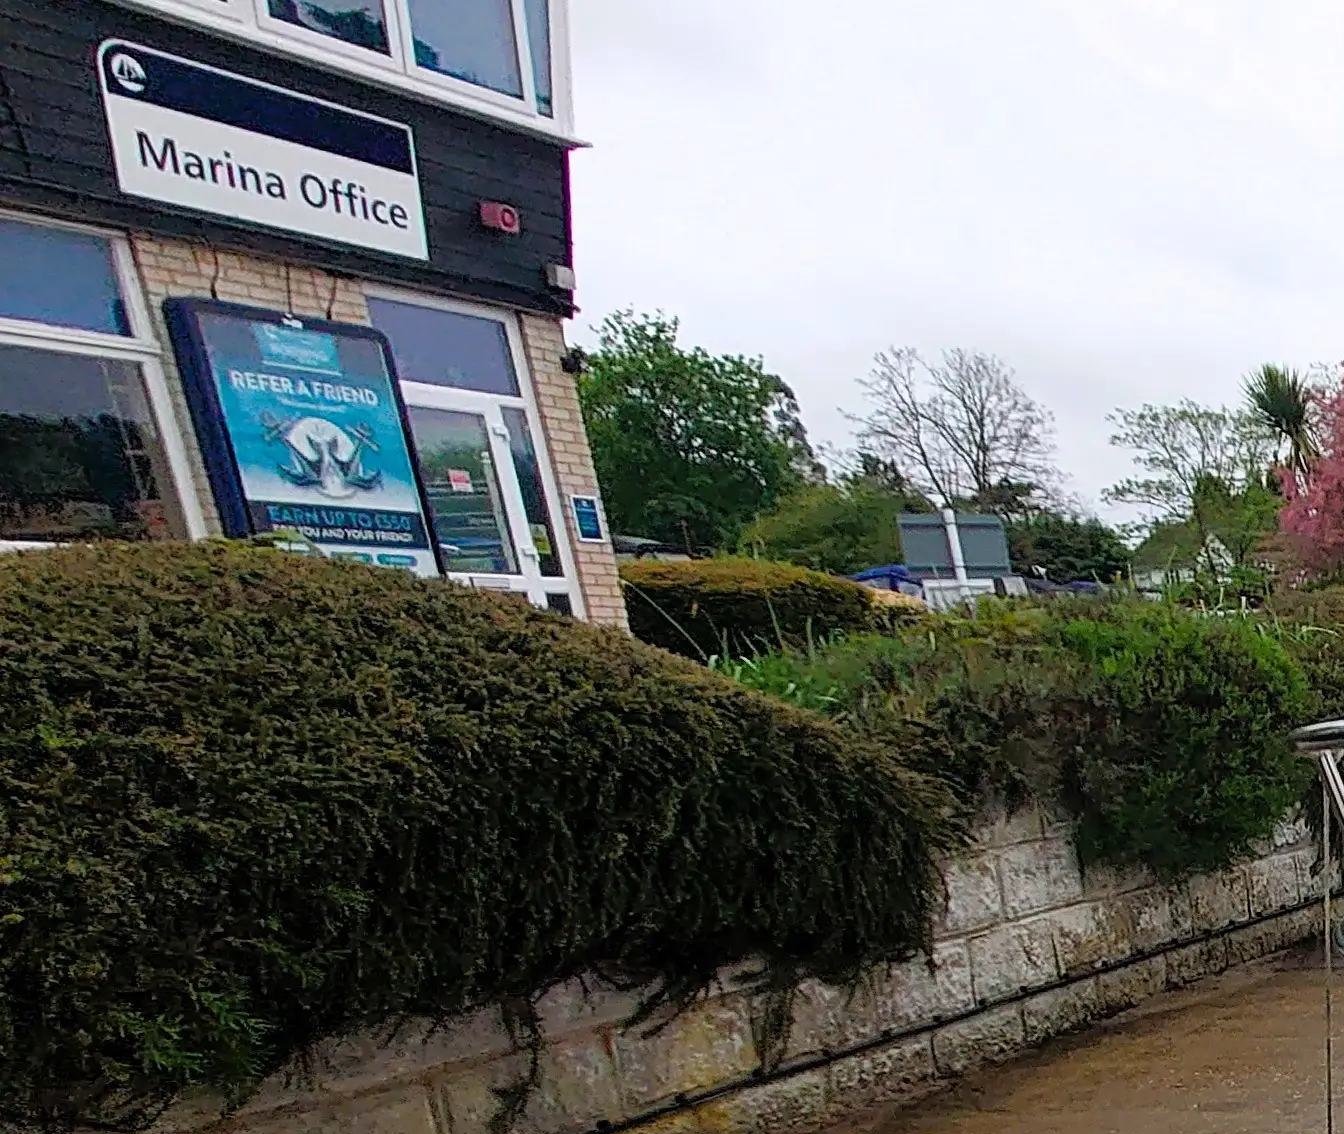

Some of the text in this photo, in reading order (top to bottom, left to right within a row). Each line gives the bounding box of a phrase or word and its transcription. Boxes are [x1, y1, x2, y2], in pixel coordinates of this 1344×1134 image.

[135, 129, 408, 229] Marina Office
[229, 369, 295, 395] REFER
[295, 379, 312, 398] A
[310, 381, 378, 406] FRIEND
[267, 505, 319, 524] EARN
[321, 510, 345, 526] UP
[348, 512, 372, 528] TO
[322, 527, 344, 540] AND
[345, 528, 375, 541] YOUR
